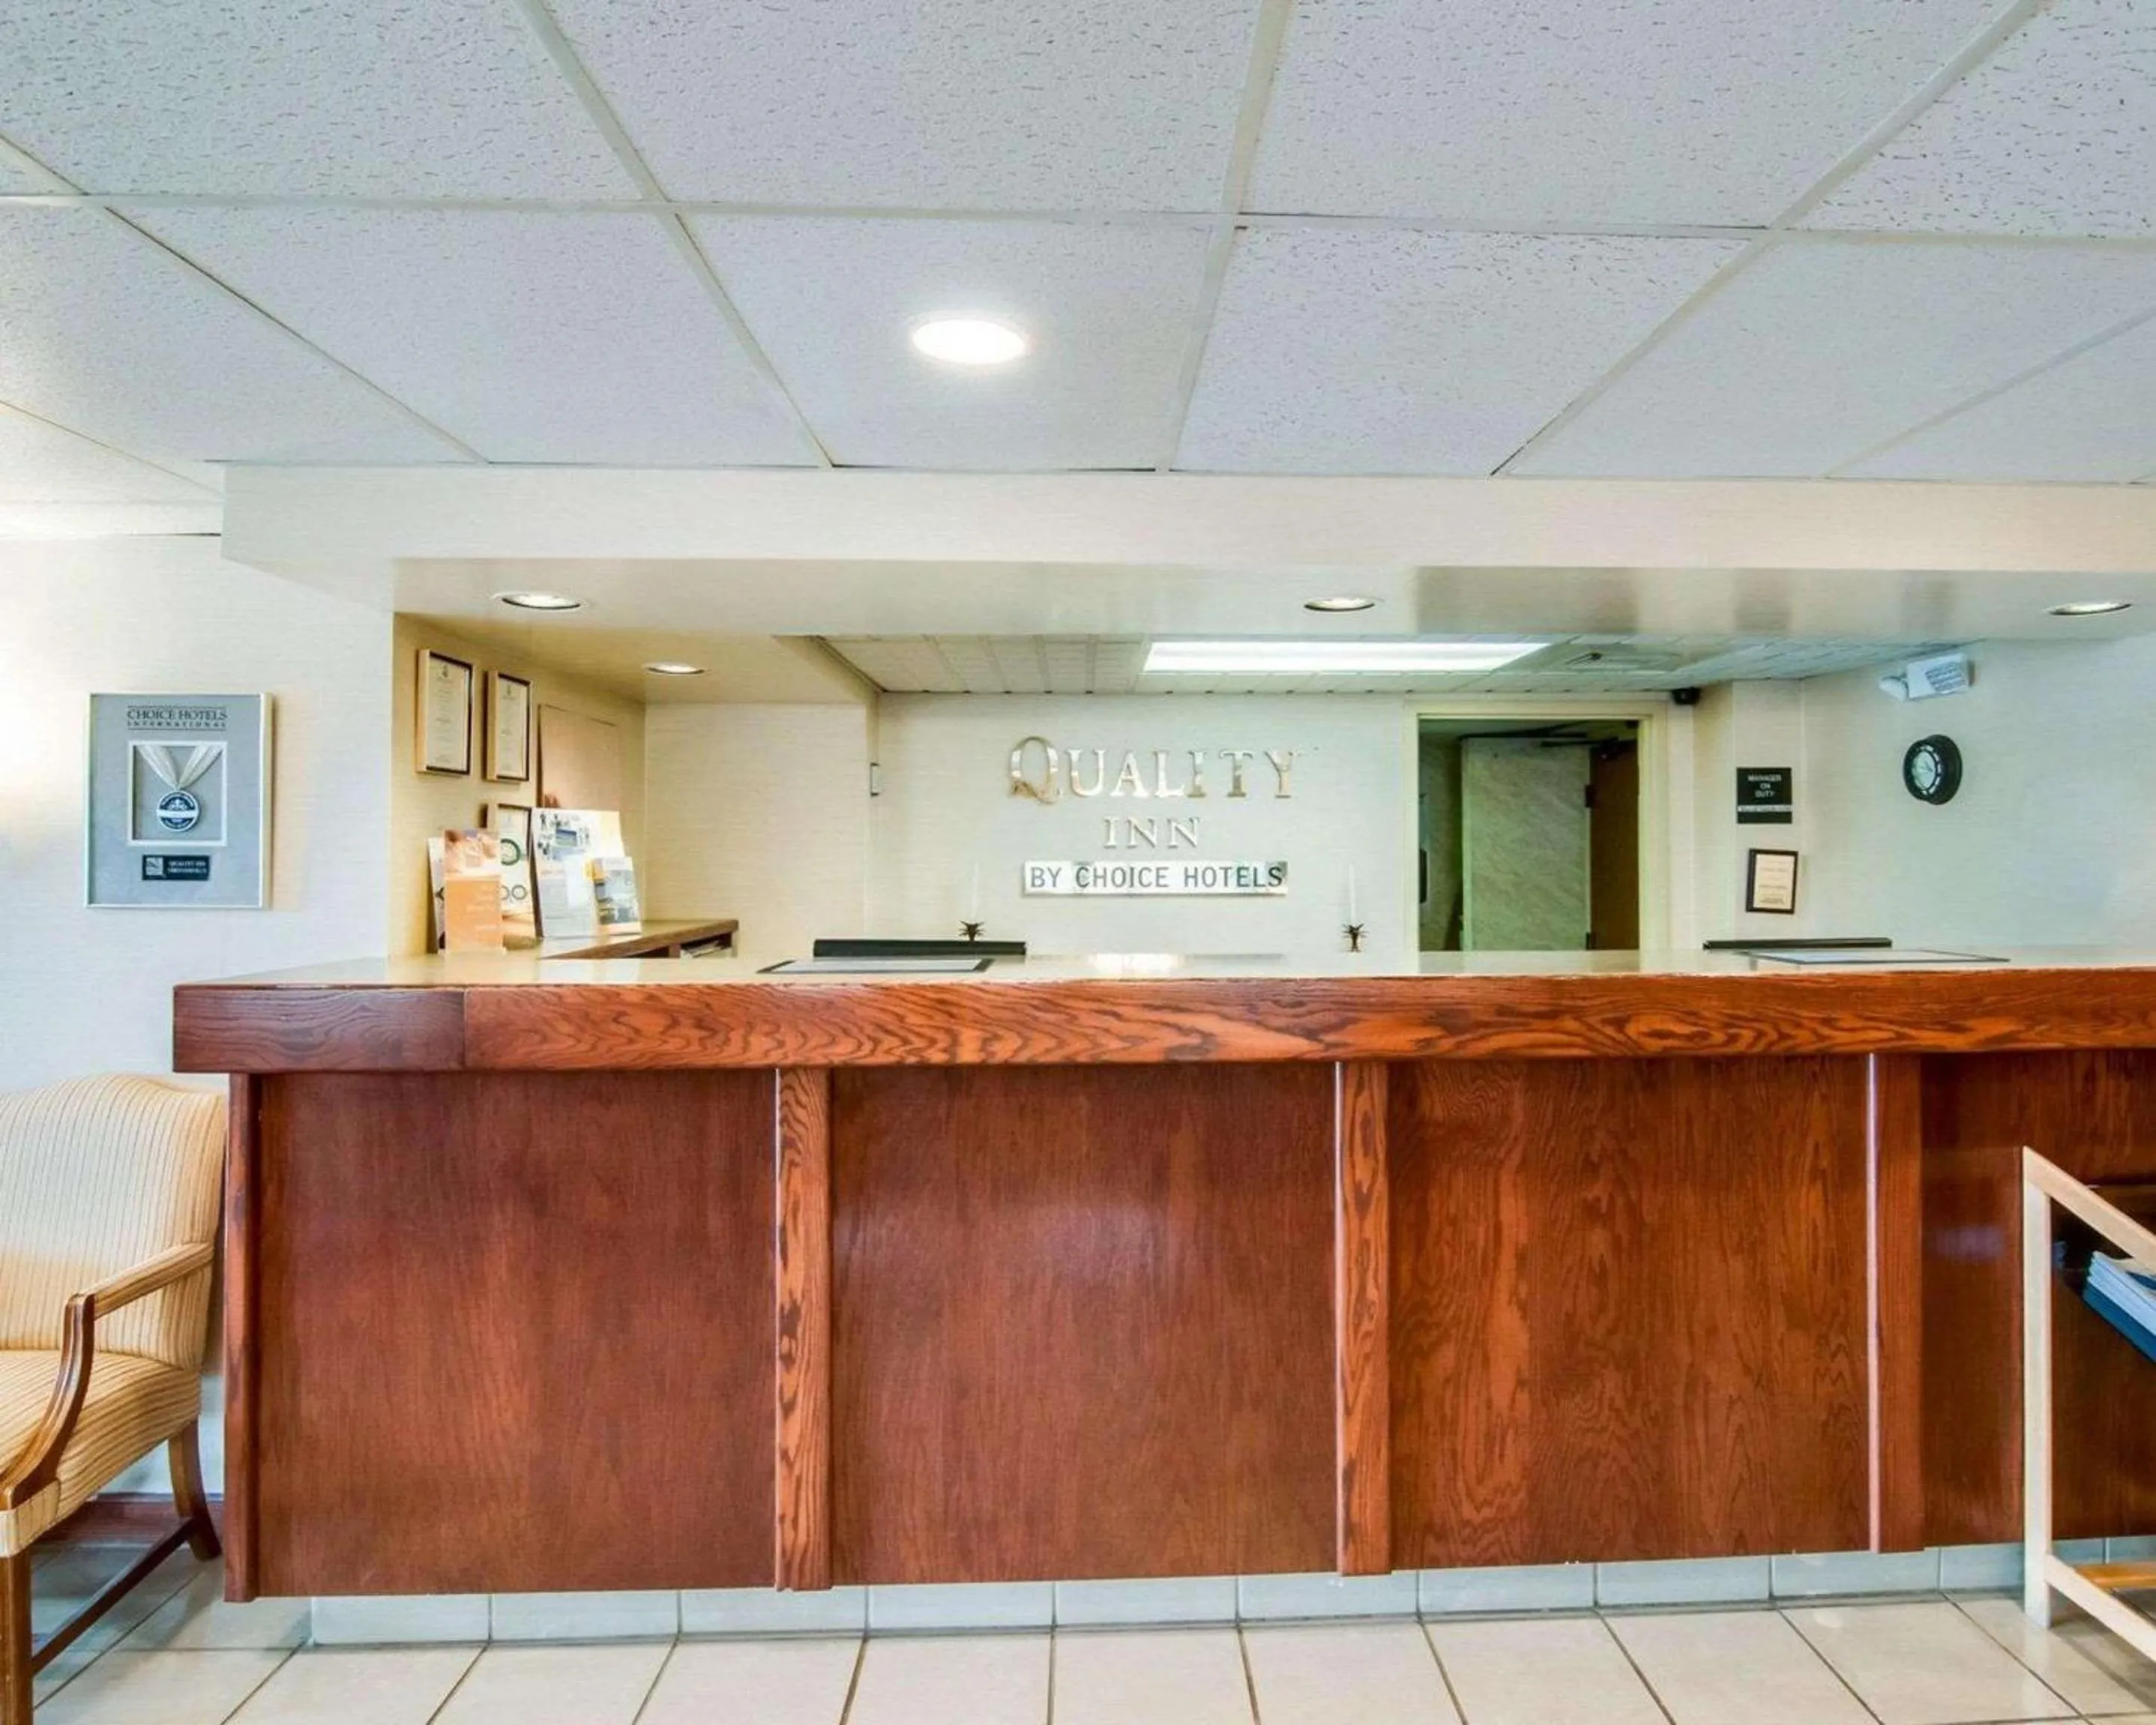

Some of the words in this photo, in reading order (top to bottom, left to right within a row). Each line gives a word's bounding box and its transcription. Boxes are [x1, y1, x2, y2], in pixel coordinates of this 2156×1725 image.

[126, 709, 173, 720] CHOICE
[178, 709, 228, 721] HOTELS
[1009, 736, 1303, 805] QUALITY
[1754, 790, 1775, 798] DUTY
[1103, 815, 1201, 850] INN
[1030, 865, 1063, 889] BY
[1075, 865, 1169, 889] CHOICE
[1183, 865, 1284, 889] HOTELS
